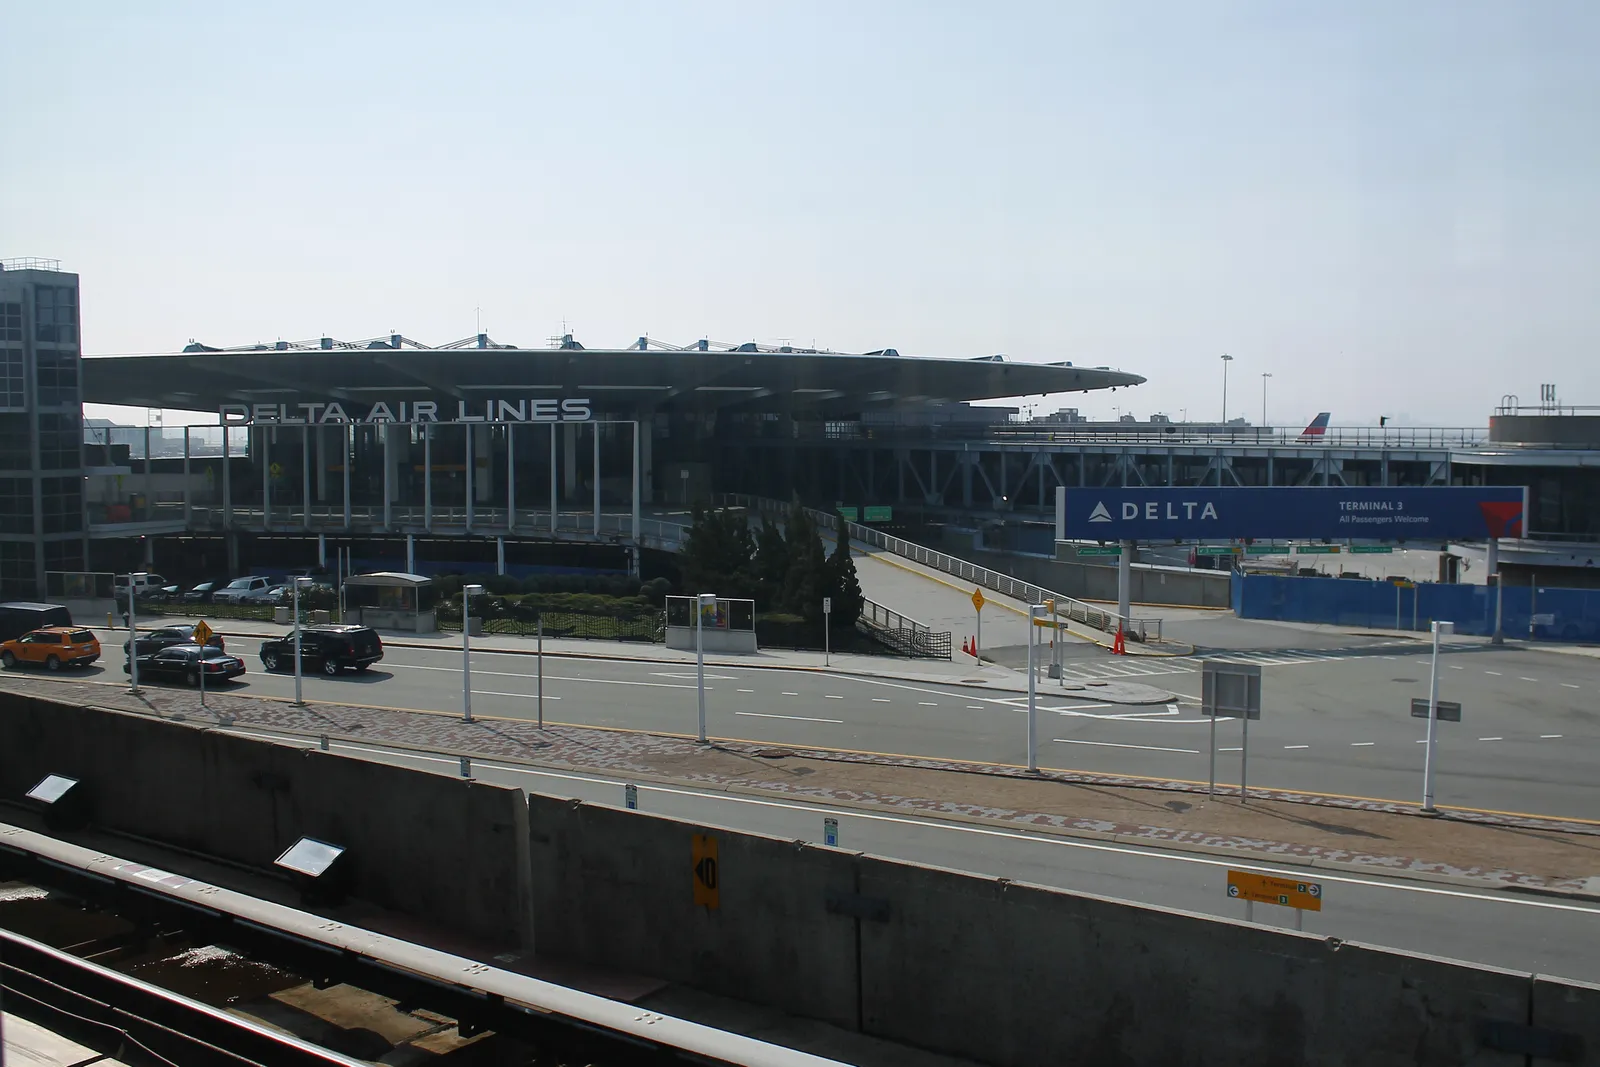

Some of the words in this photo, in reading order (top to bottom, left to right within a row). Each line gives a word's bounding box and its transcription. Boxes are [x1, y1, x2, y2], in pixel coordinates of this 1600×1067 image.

[219, 402, 350, 425] DELTA
[365, 401, 438, 423] AIR
[458, 398, 591, 422] LINES
[1122, 501, 1219, 520] DELTA
[1339, 501, 1394, 511] TERMINAL
[1396, 501, 1404, 511] 3
[1339, 515, 1350, 524] All
[1351, 515, 1393, 525] Passengers
[1394, 515, 1430, 524] Welcome
